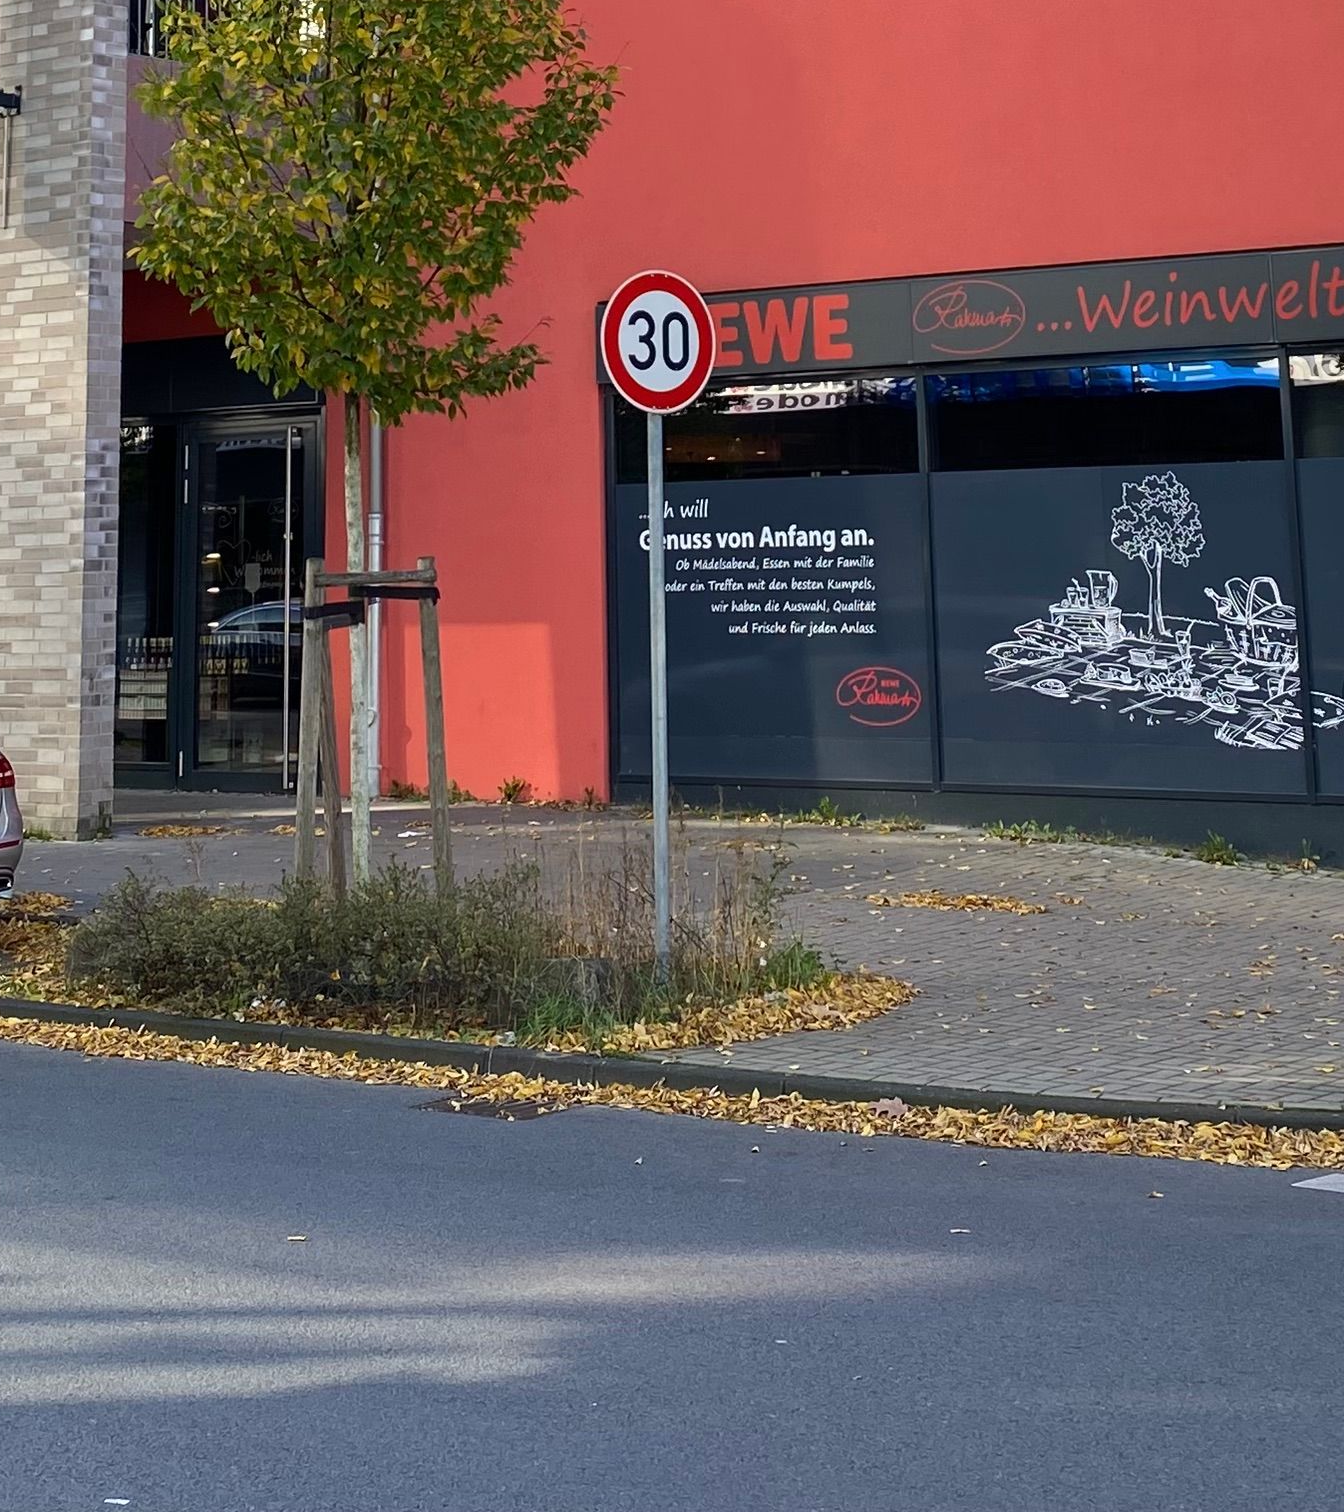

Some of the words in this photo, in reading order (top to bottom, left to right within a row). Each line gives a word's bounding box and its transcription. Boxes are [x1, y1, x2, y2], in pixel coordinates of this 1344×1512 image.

[709, 293, 854, 367] EWE
[628, 310, 689, 371] 30
[639, 500, 674, 519] ...h
[680, 499, 709, 518] will
[716, 531, 754, 549] von
[759, 524, 836, 553] Anfang
[841, 528, 875, 547] an.
[675, 560, 689, 571] Ob
[762, 558, 790, 570] Essen
[794, 557, 812, 569] mit
[816, 556, 833, 568] der
[837, 556, 875, 569] Familie
[665, 580, 688, 592] oder
[690, 579, 705, 591] ein
[708, 578, 744, 591] Treffen
[747, 578, 765, 590] mit
[769, 577, 788, 590] den
[791, 576, 824, 590] besten
[827, 576, 876, 593] Kumpels,
[710, 601, 728, 613] wir
[731, 600, 761, 613] haben
[764, 600, 780, 612] die
[783, 599, 830, 614] Auswahl,
[833, 599, 877, 613] Qualität
[728, 622, 749, 634] und
[752, 622, 787, 634] Frische
[790, 621, 806, 634] für
[808, 621, 837, 637] jeden
[840, 621, 878, 634] Anlass.
